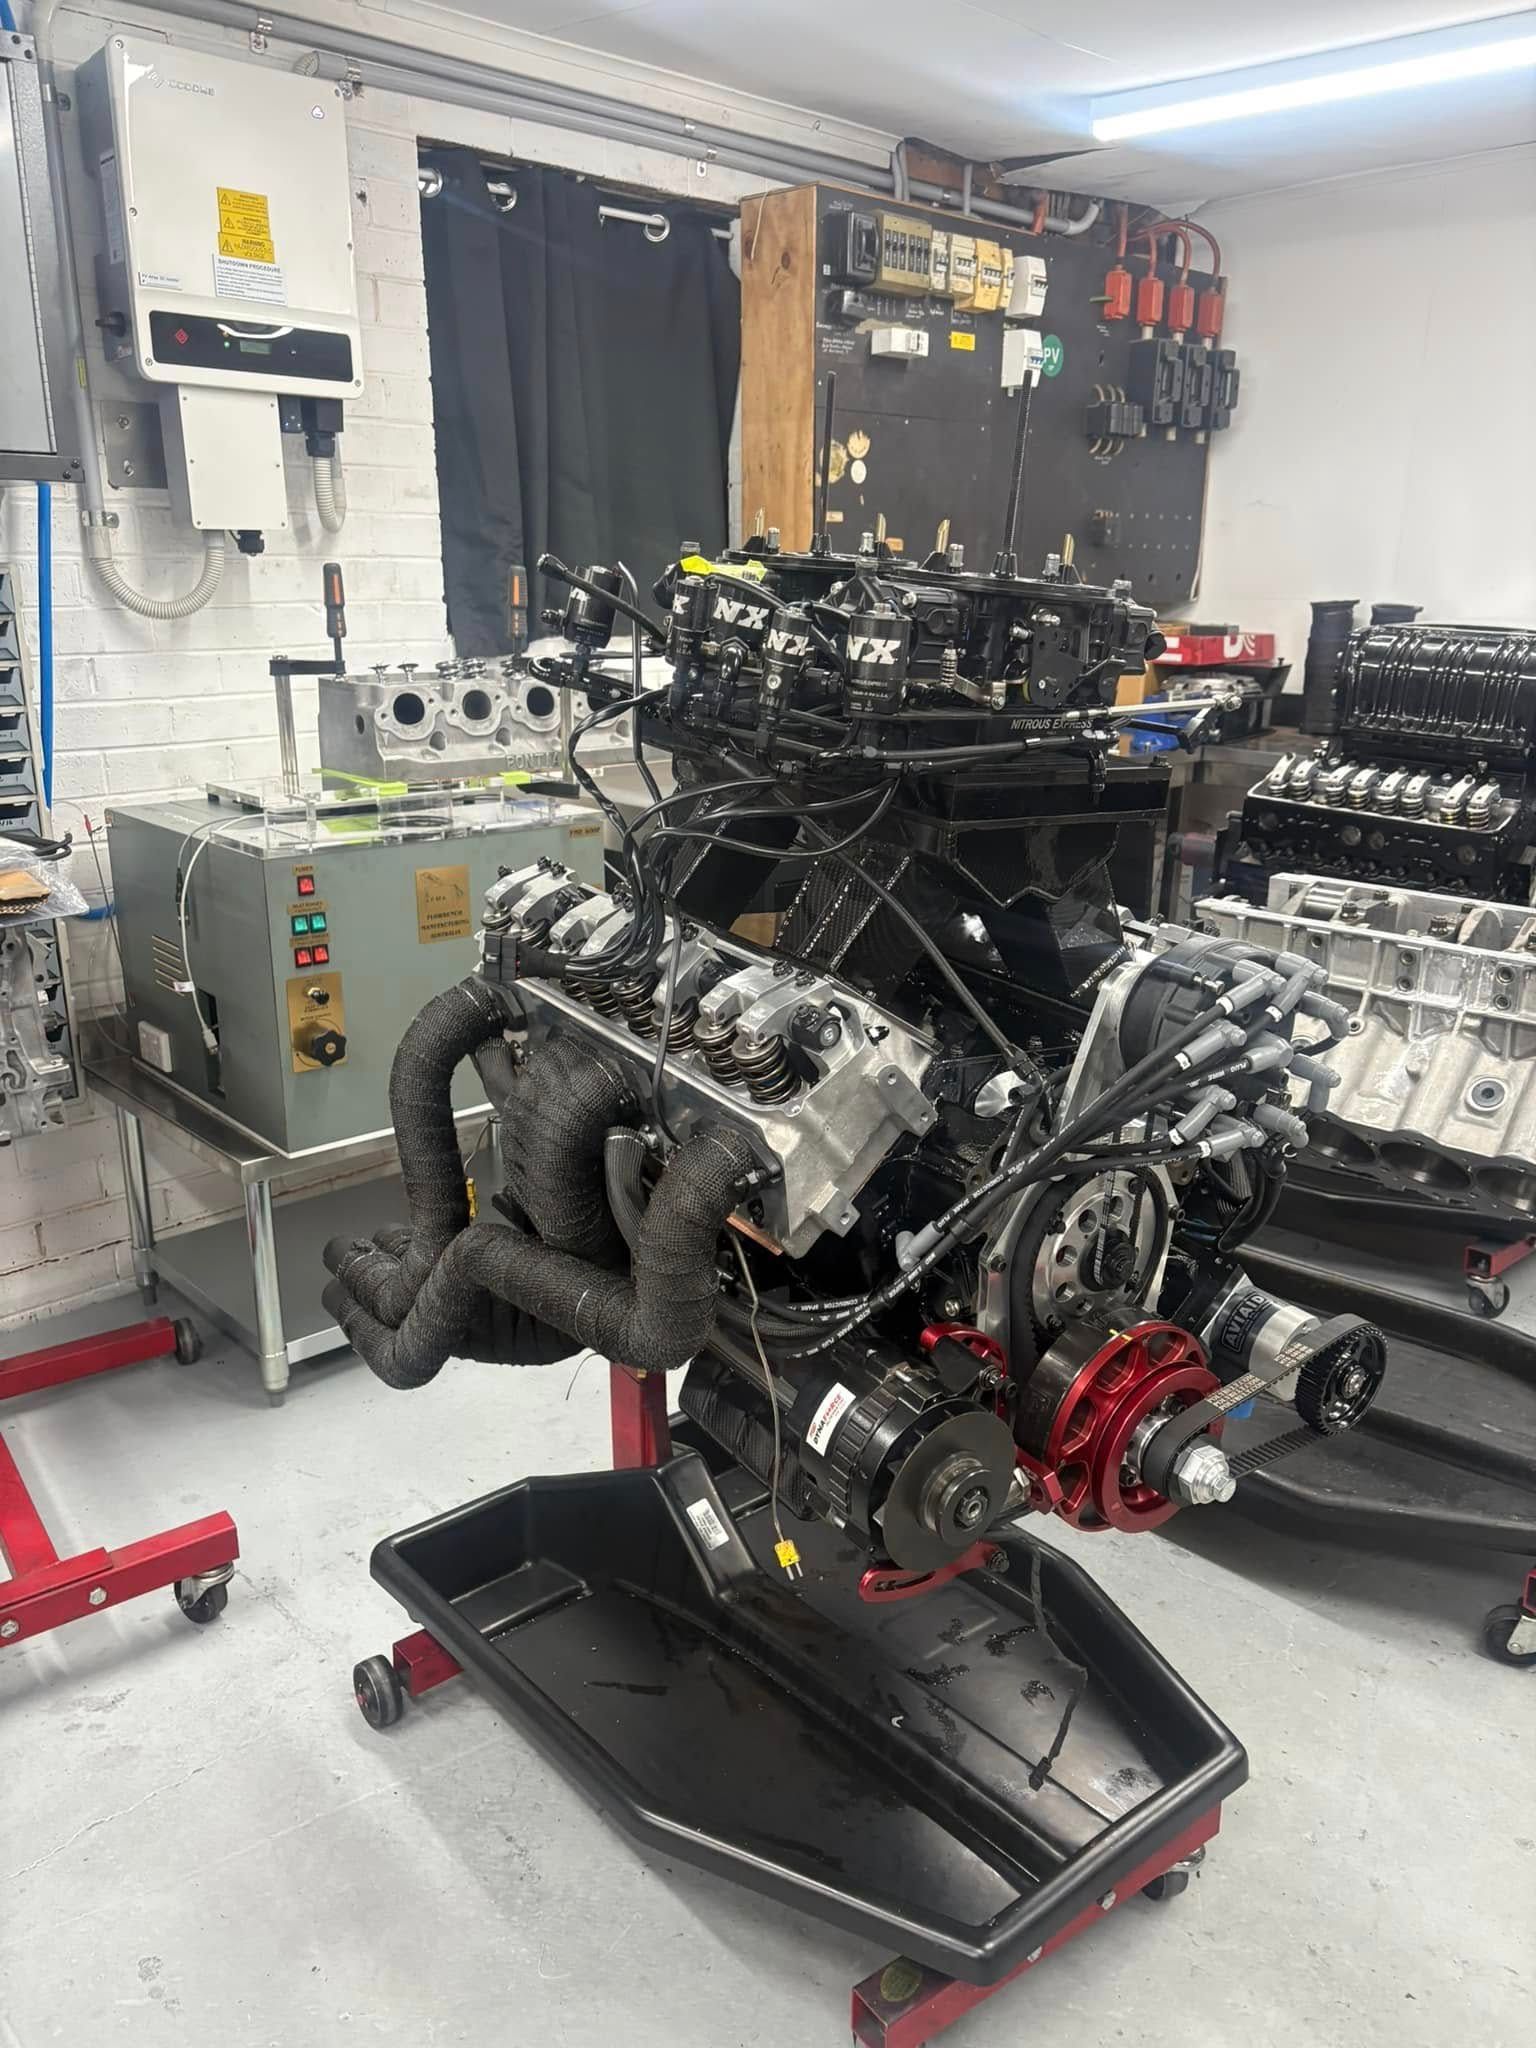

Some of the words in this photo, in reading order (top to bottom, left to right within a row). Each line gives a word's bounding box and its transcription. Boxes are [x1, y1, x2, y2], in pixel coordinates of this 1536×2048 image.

[1044, 347, 1060, 364] PV
[713, 596, 770, 631] NX
[767, 628, 809, 657] NX
[847, 634, 902, 665] NX
[1010, 718, 1051, 730] NITROUS
[972, 1174, 1005, 1199] CONDUCTOR
[952, 1198, 971, 1215] SPARK
[936, 1213, 952, 1229] PLUG
[823, 1298, 859, 1311] CONDUCTOR
[1224, 1294, 1266, 1348] AVIAID
